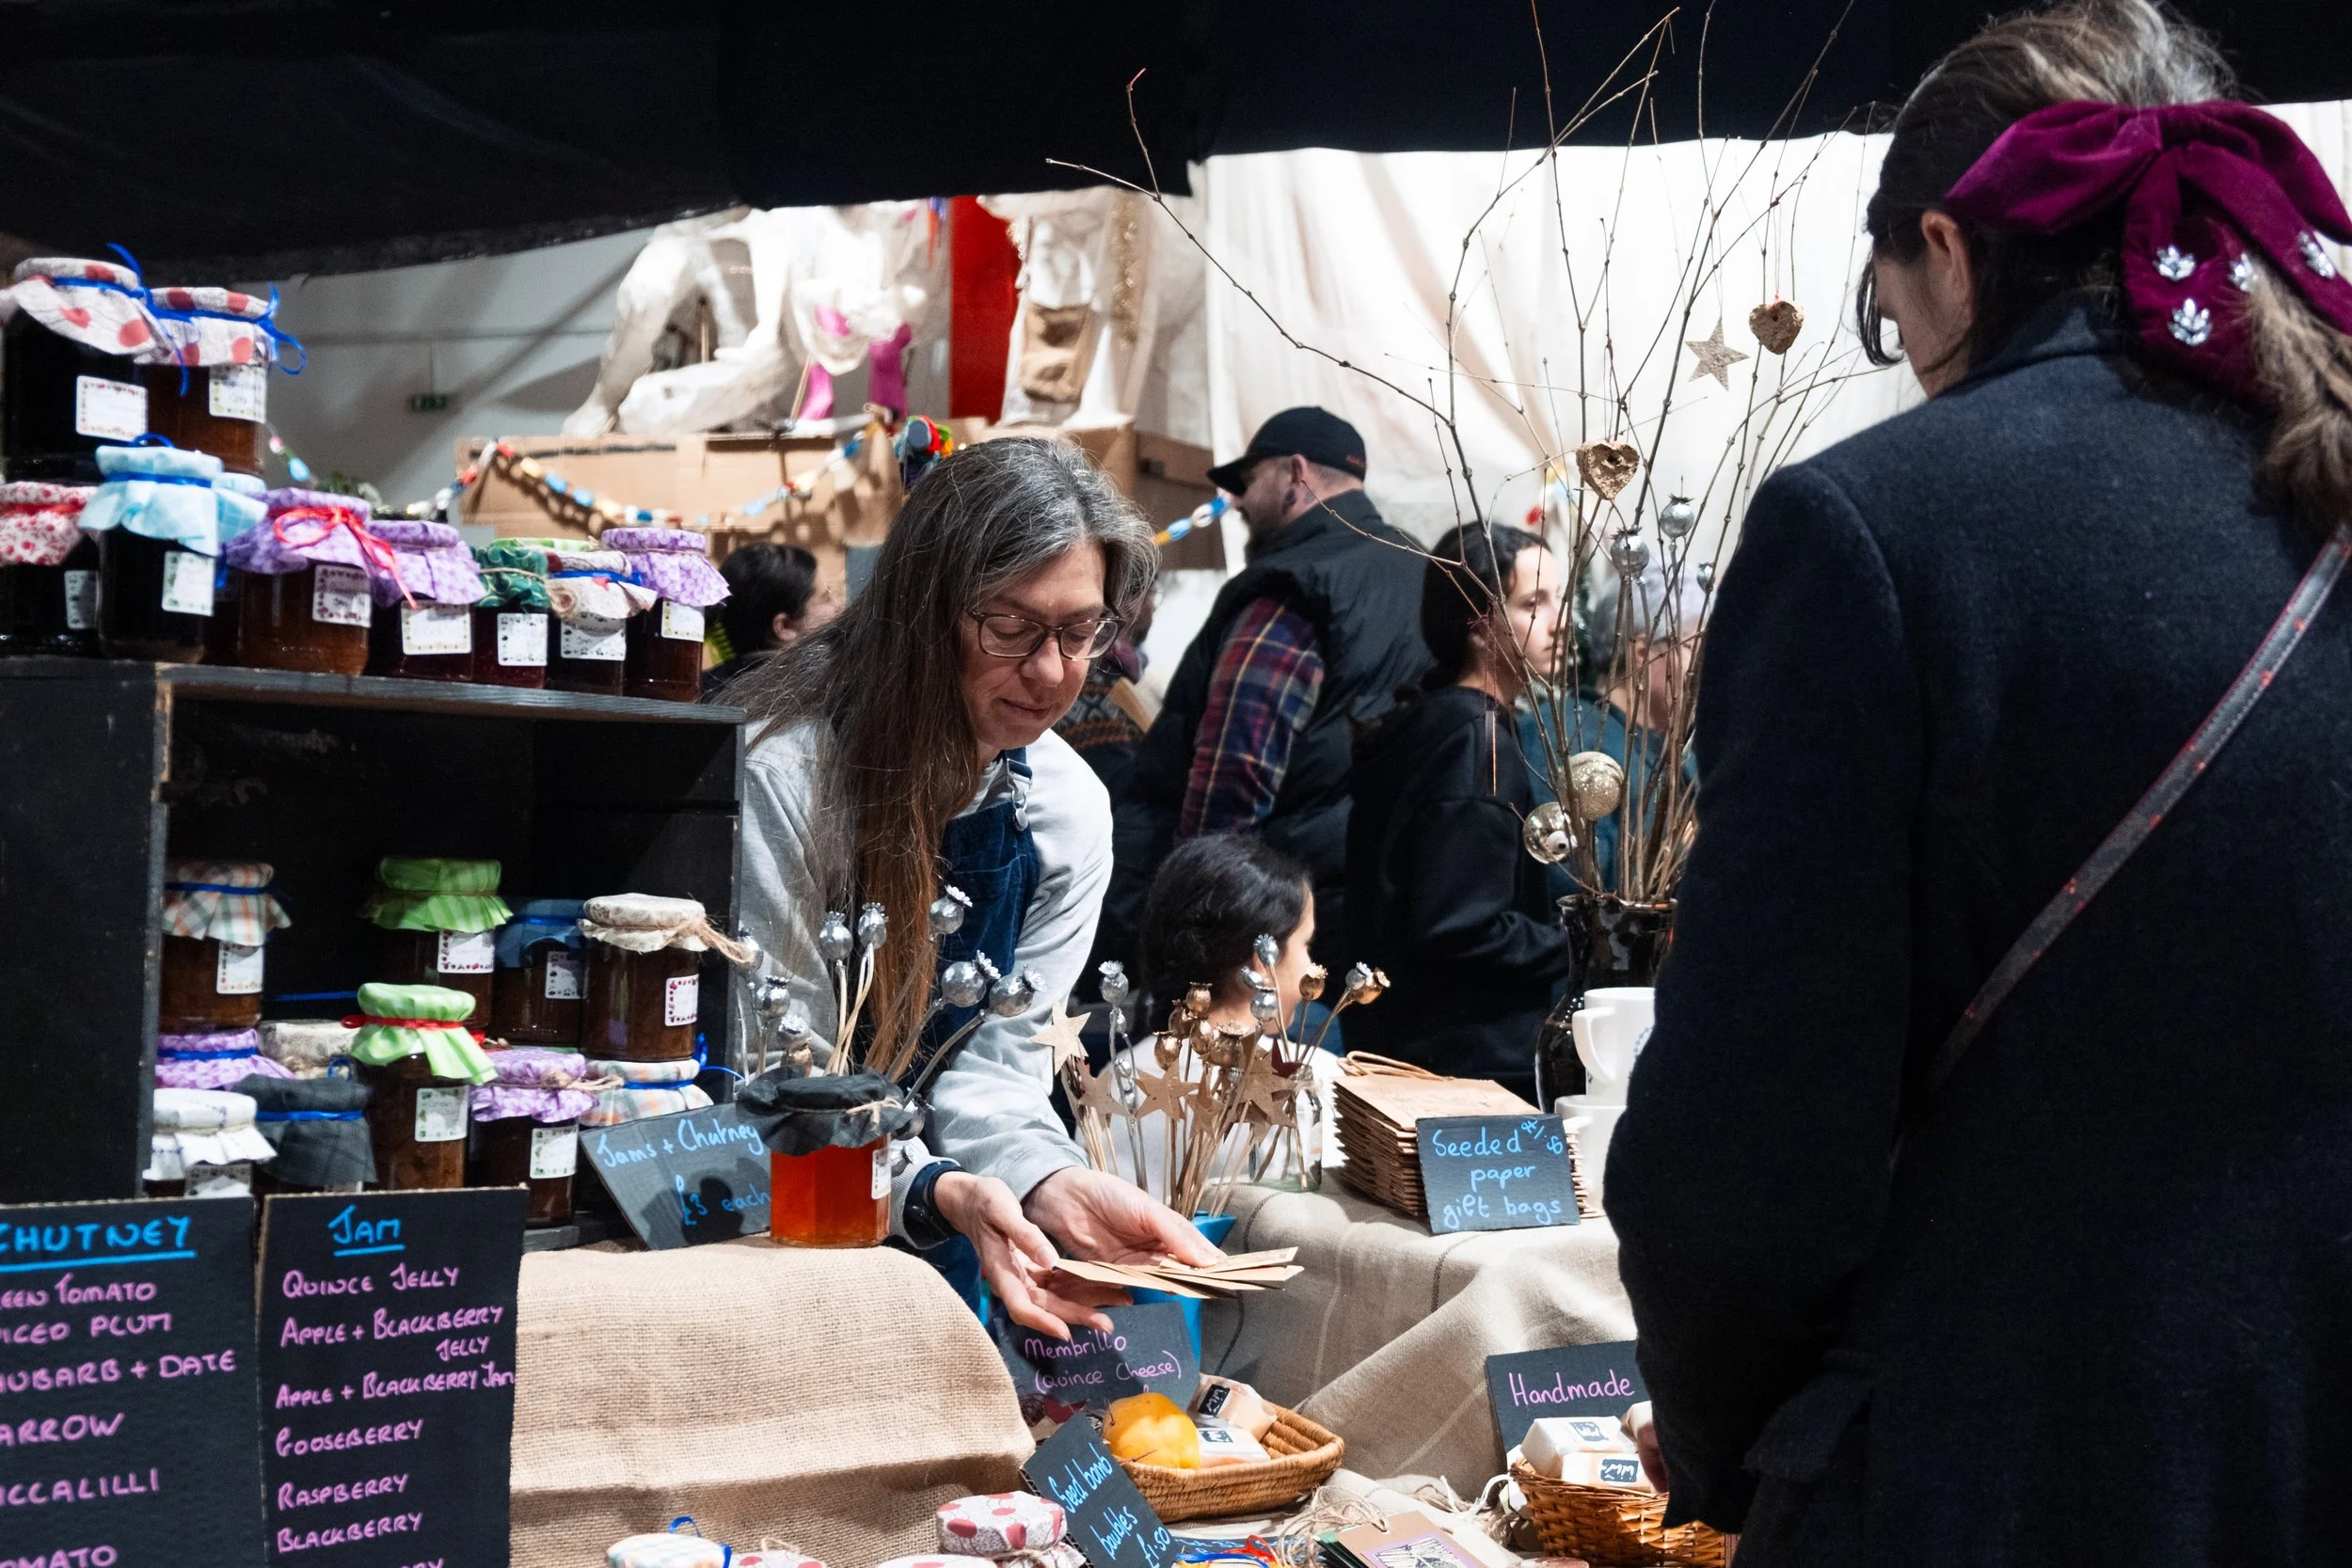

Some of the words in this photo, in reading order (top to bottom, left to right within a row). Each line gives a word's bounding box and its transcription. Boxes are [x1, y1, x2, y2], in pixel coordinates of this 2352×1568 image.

[596, 1132, 657, 1167] Jams
[662, 1138, 675, 1155] +
[677, 1118, 764, 1155] Chutney
[1432, 1126, 1522, 1158] Seeded
[1470, 1164, 1536, 1193] paper
[675, 1174, 707, 1226] £3
[721, 1183, 771, 1212] each
[1442, 1194, 1490, 1229] gift
[1503, 1196, 1562, 1227] bags
[326, 1204, 401, 1244] JAM
[0, 1289, 50, 1309] EEN
[54, 1272, 158, 1305] TOMATO
[282, 1269, 374, 1299] QUINCE
[389, 1261, 461, 1291] JELLY
[0, 1322, 71, 1345] ICED
[279, 1316, 347, 1348] APPLE
[352, 1323, 366, 1341] +
[373, 1307, 504, 1340] BLACKBERRY
[1024, 1328, 1127, 1361] Membrillo
[130, 1360, 149, 1380] +
[158, 1348, 235, 1378] DATE
[435, 1336, 490, 1362] JELLY
[275, 1383, 334, 1409] APPLE
[341, 1385, 356, 1401] +
[361, 1370, 478, 1400] BLACKBERRY
[1035, 1368, 1105, 1396] (Quince
[1115, 1349, 1182, 1381] Cheese)
[1507, 1368, 1635, 1407] Handmade
[275, 1418, 423, 1457] GOOSEBERRY
[278, 1473, 409, 1511] RASPBERRY
[1047, 1464, 1089, 1513] Seed
[1072, 1441, 1114, 1491] bomb
[277, 1512, 423, 1555] BLACKBERRY
[1089, 1505, 1139, 1561] baubles
[1136, 1526, 1171, 1568] £1.50
